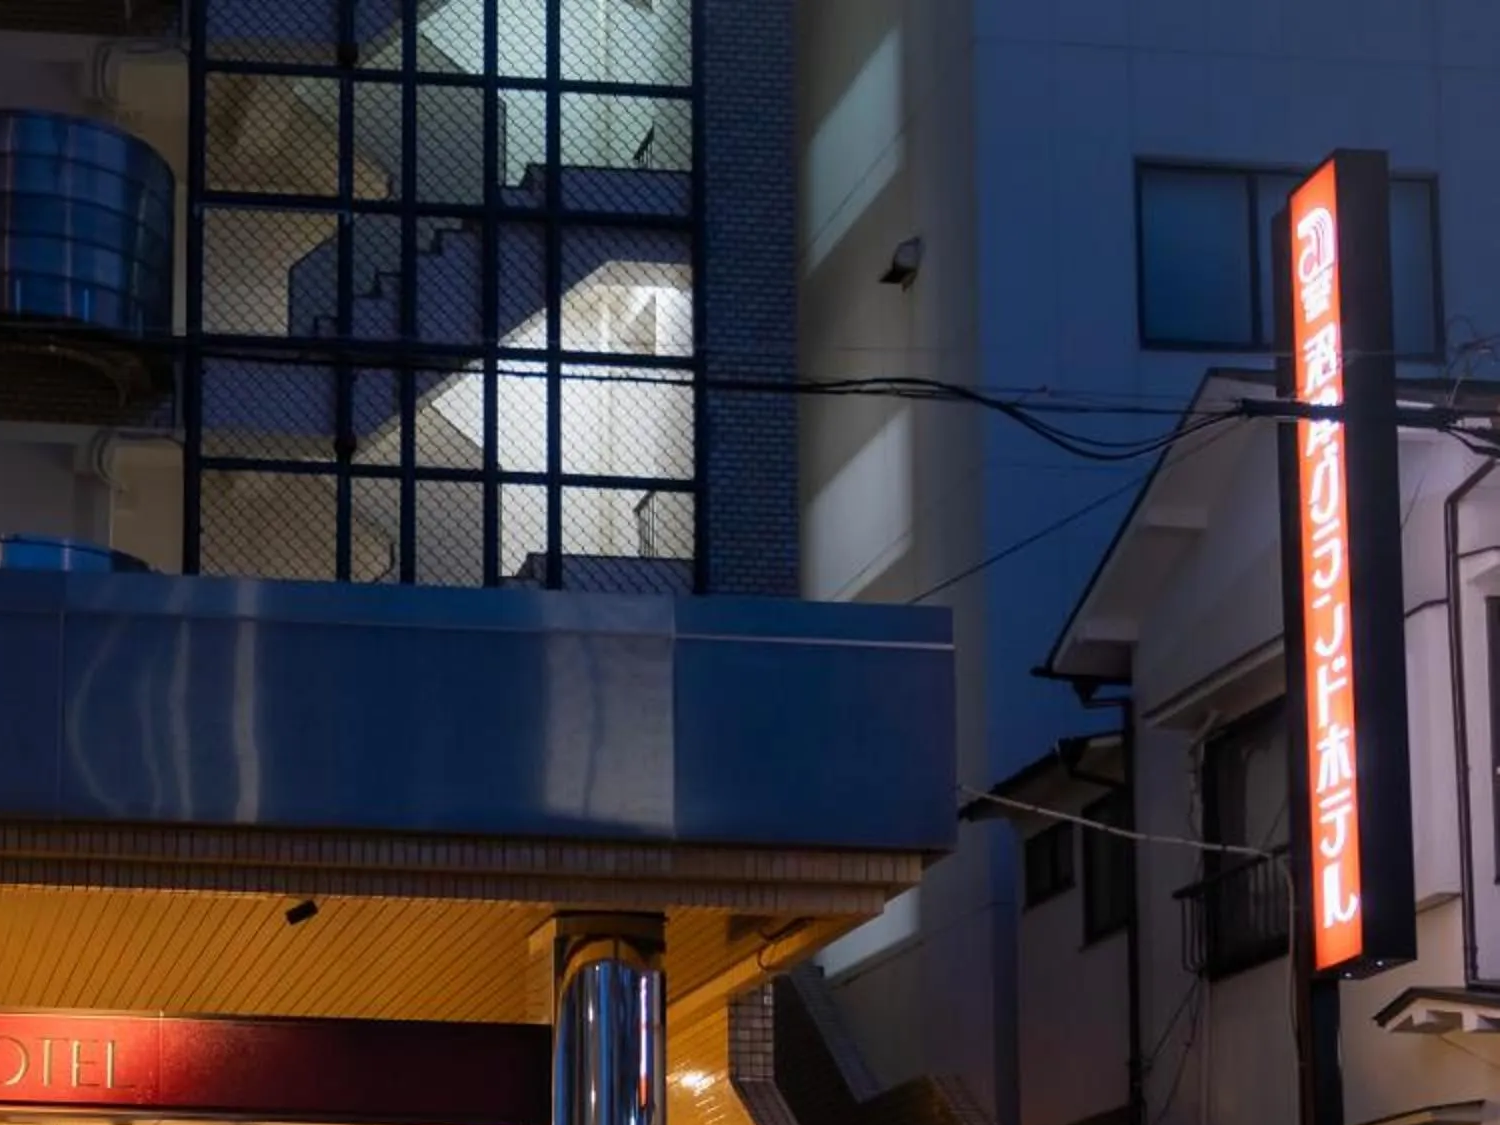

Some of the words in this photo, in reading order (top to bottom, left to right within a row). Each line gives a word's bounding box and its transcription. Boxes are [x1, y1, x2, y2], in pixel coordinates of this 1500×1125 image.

[1303, 322, 1360, 929] 沼津グランドホテル
